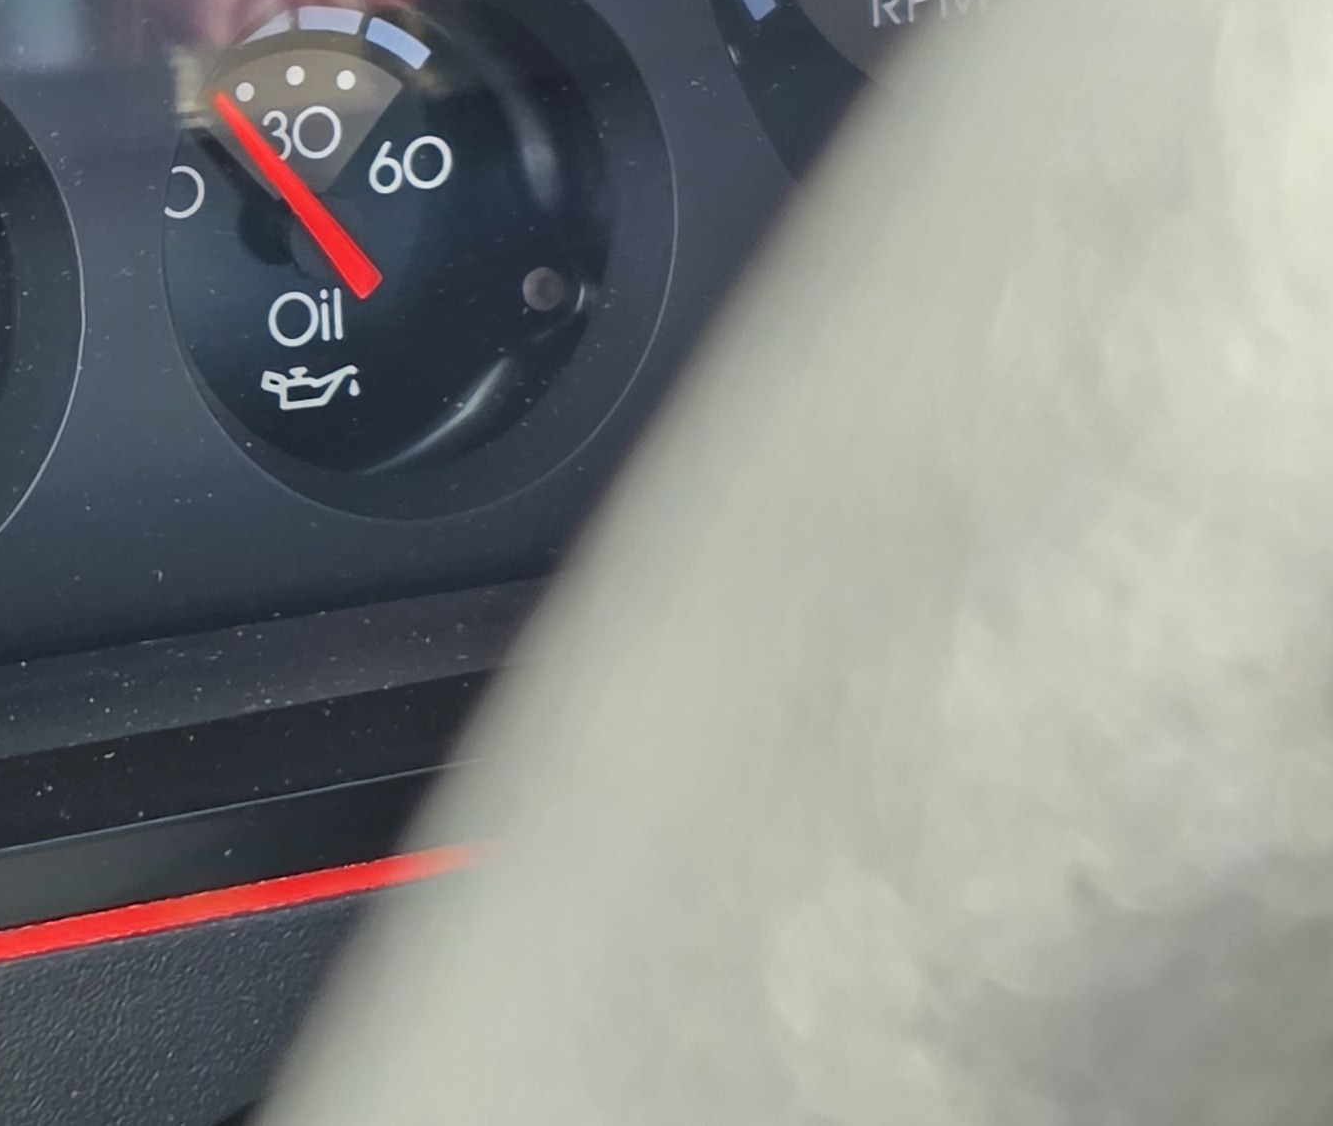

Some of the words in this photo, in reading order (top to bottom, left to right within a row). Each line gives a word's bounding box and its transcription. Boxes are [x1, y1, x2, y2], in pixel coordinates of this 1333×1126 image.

[261, 105, 342, 161] 30
[368, 134, 453, 195] 60
[267, 286, 345, 348] Oil
